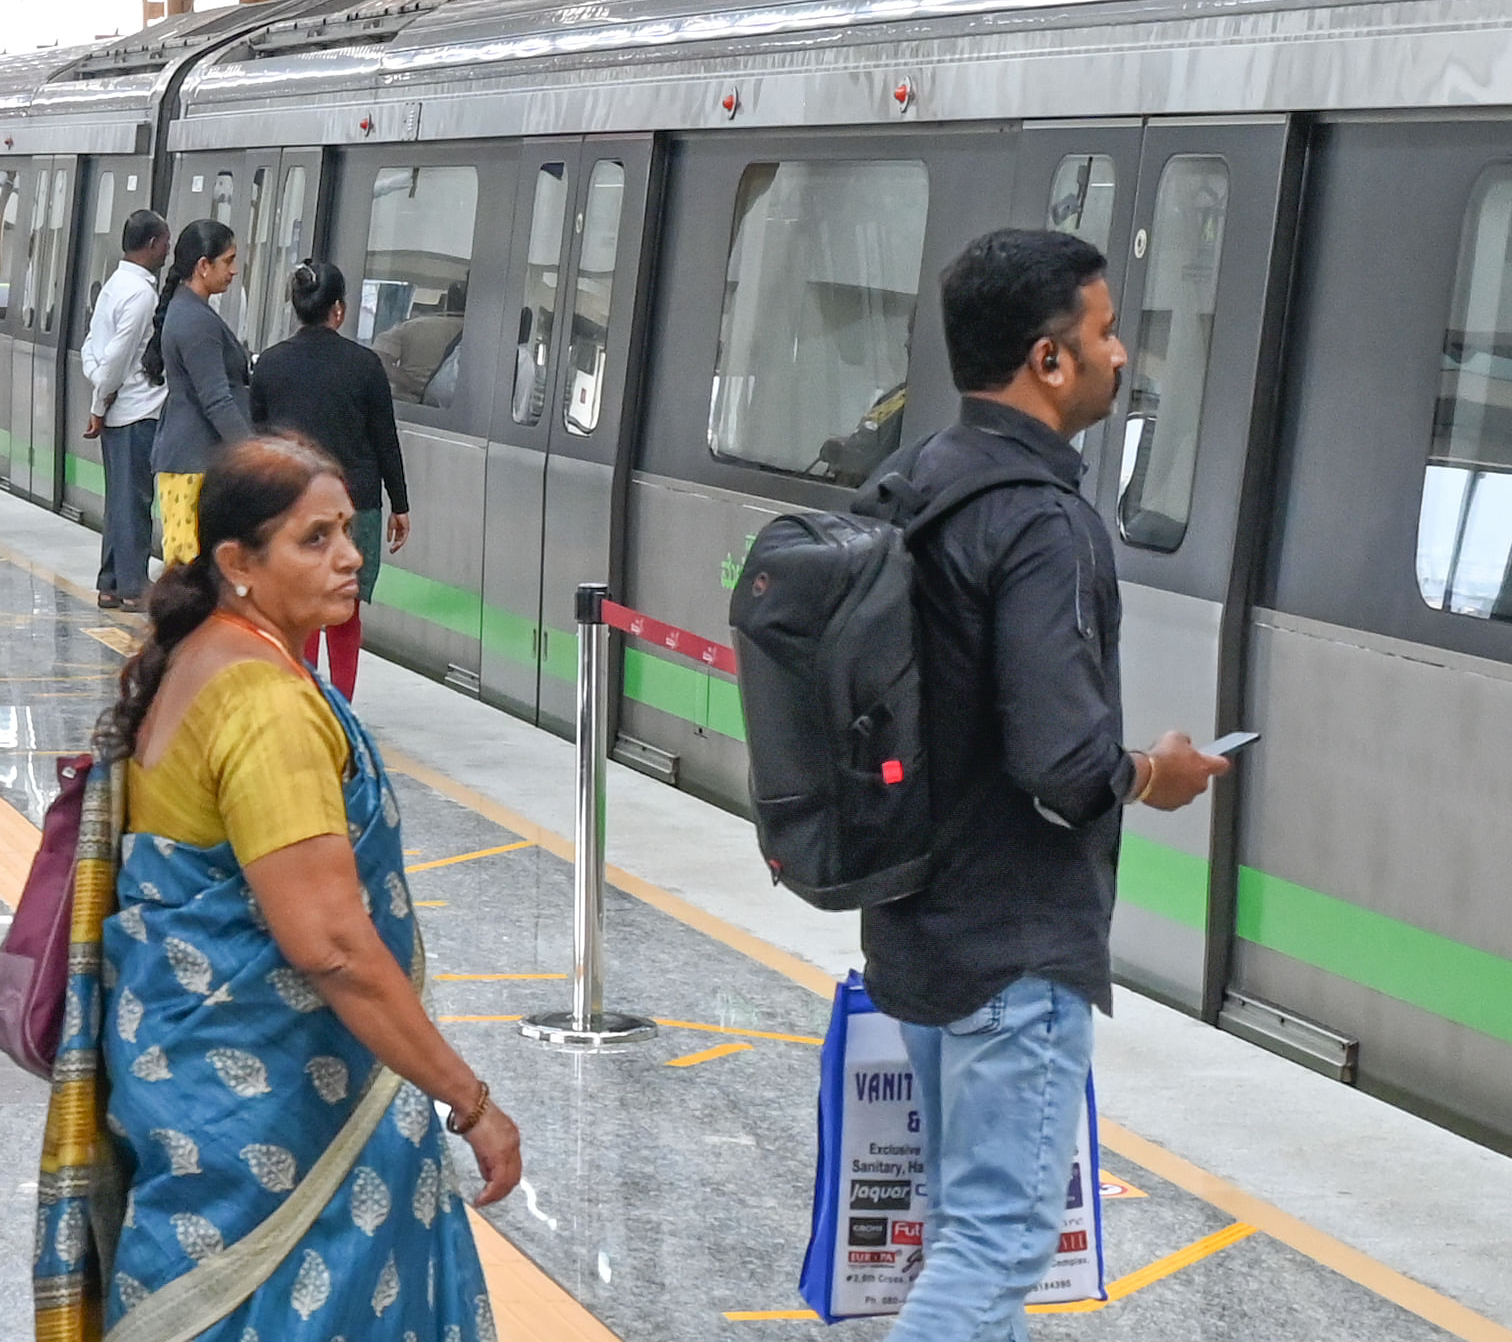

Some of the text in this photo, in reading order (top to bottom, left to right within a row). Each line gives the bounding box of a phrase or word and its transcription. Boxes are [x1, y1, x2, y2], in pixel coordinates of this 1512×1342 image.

[907, 1110, 920, 1133] &
[869, 1142, 921, 1155] Exclusive
[852, 1159, 905, 1178] Sanitary,
[850, 1183, 909, 1203] Jaquar
